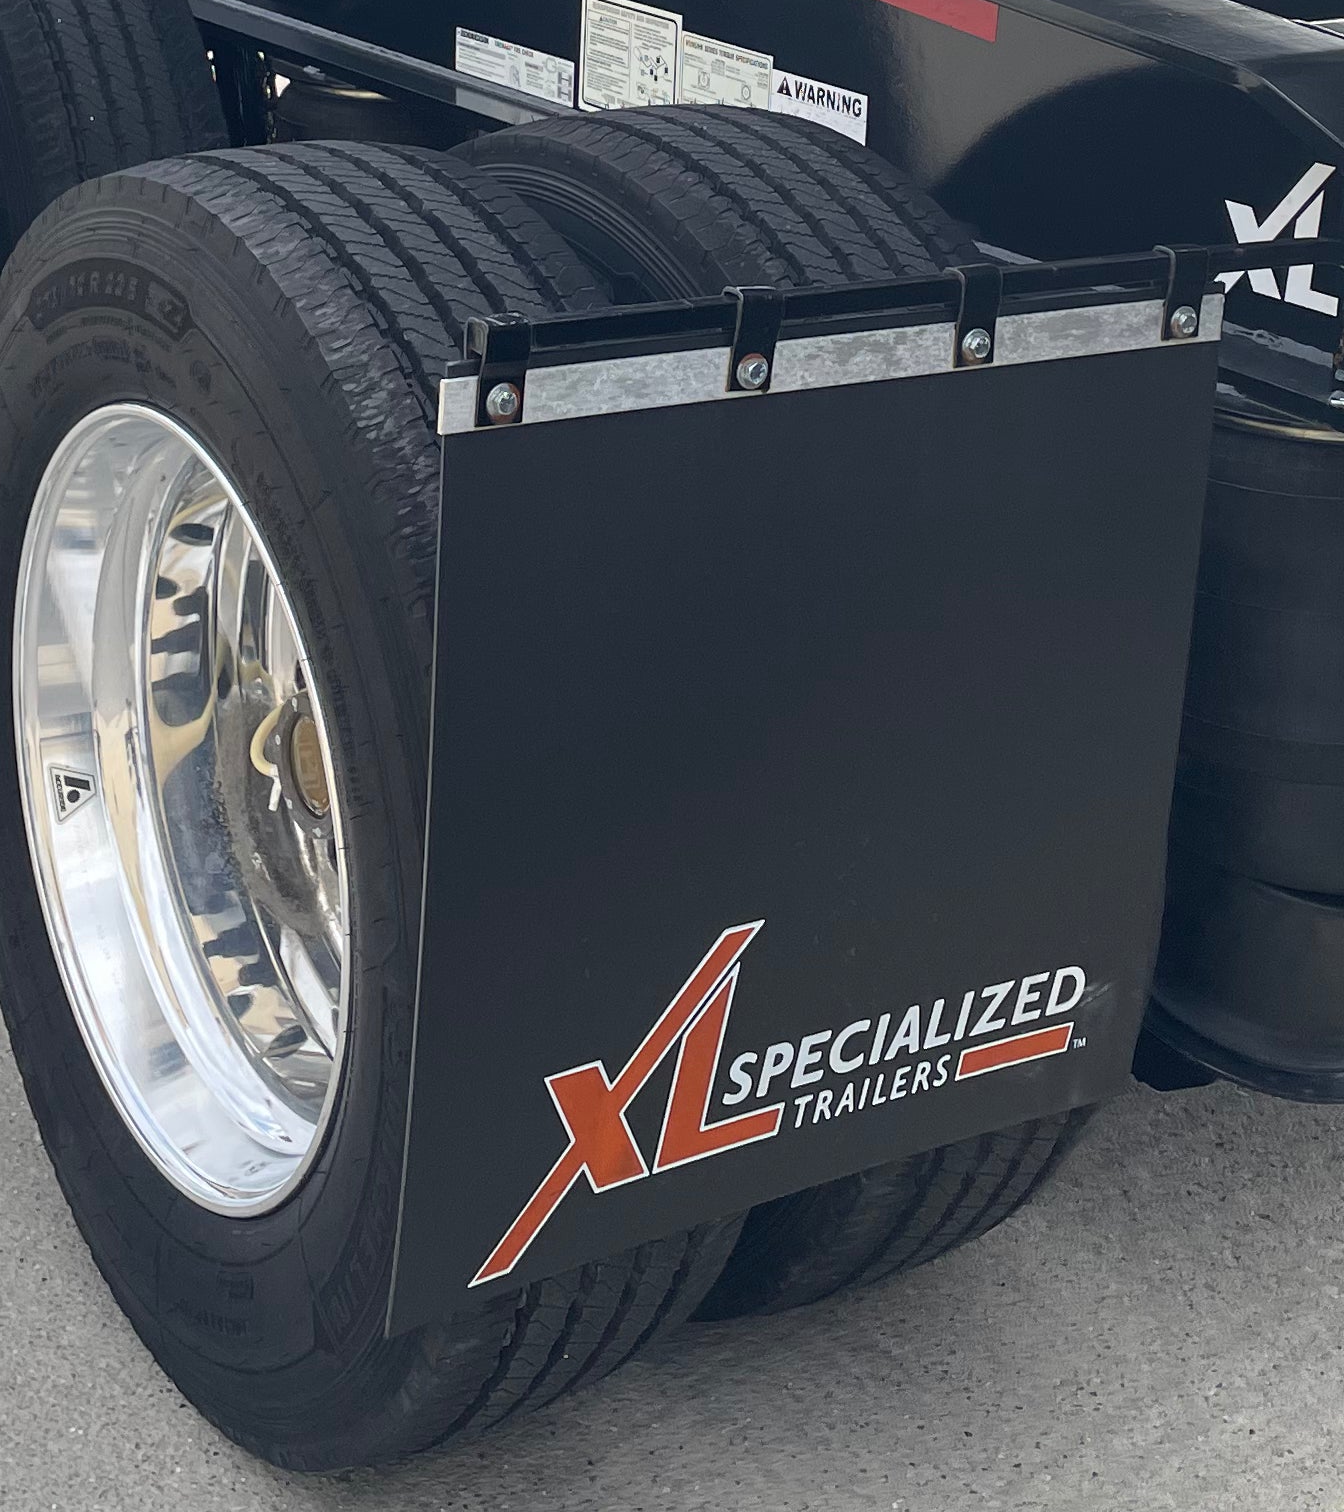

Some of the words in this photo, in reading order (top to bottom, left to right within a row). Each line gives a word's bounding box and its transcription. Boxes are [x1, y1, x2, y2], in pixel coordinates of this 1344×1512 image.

[794, 79, 862, 118] WARNING
[1215, 162, 1338, 317] XL
[467, 919, 785, 1288] XL
[722, 964, 1087, 1106] SPECIALIZED
[792, 1054, 953, 1130] TRAILERS
